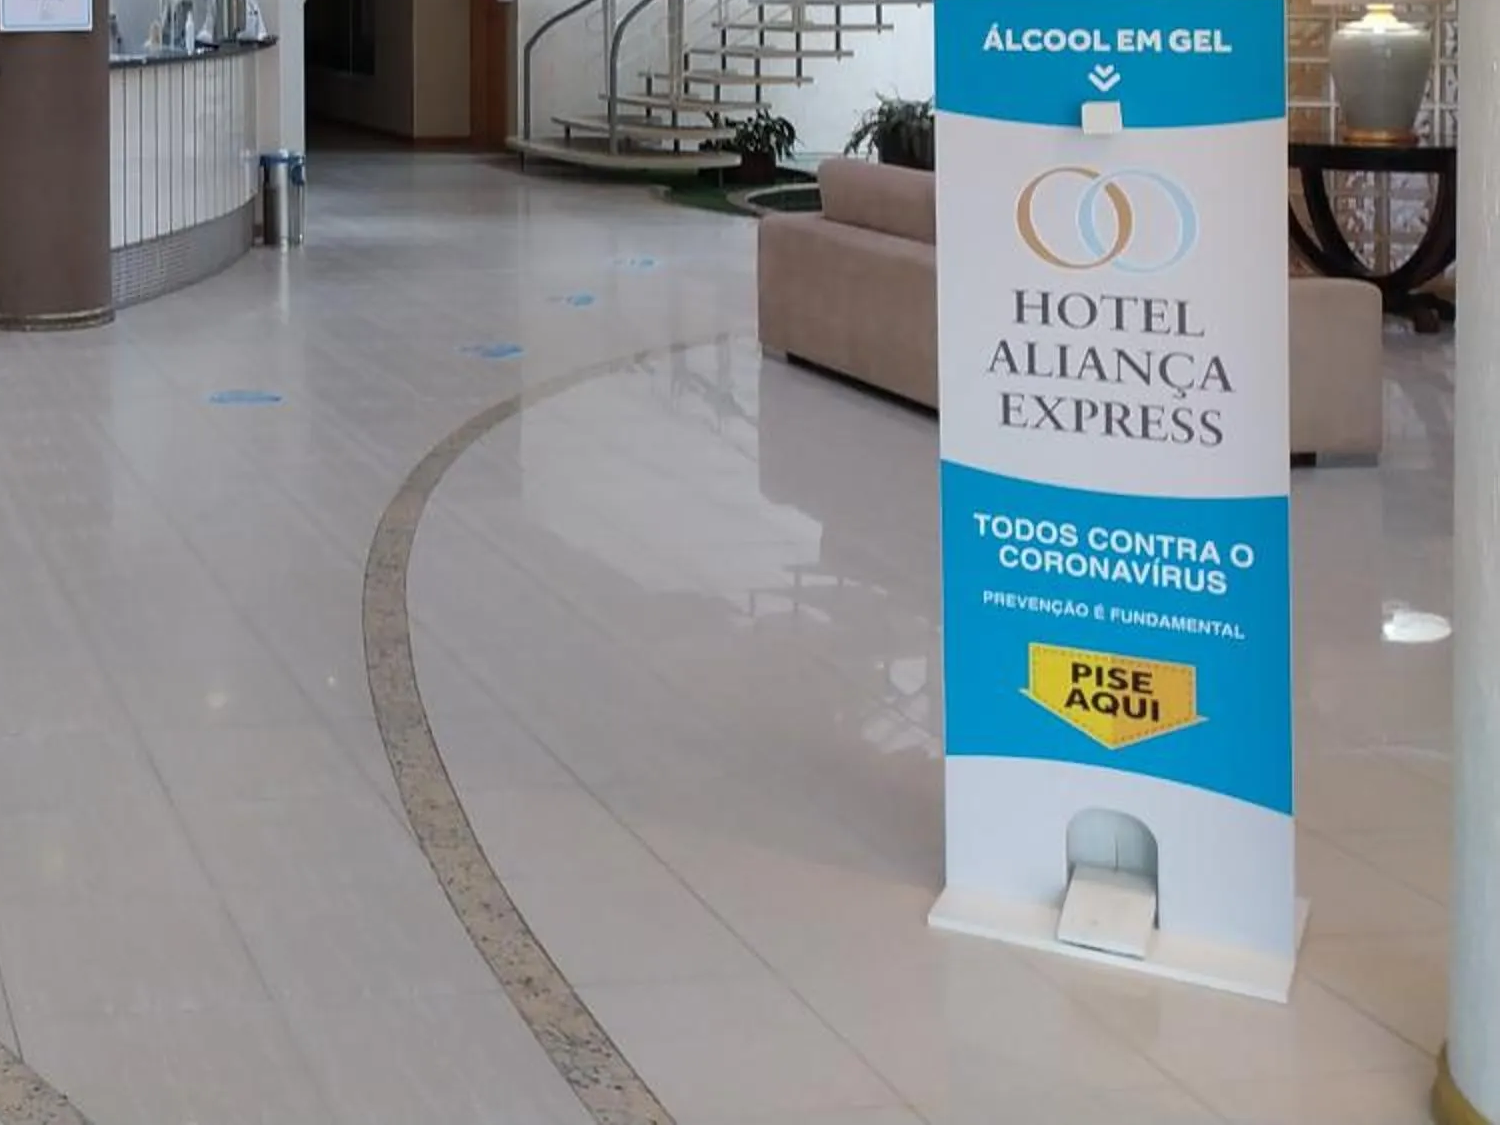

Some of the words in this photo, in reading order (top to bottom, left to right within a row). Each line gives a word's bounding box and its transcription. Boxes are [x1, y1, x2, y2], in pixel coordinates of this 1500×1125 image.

[983, 23, 1111, 52] ÁLCOOL
[1117, 29, 1162, 52] EM
[1169, 29, 1232, 53] GEL
[1011, 289, 1205, 337] HOTEL
[986, 339, 1236, 399] ALIANÇA
[999, 392, 1225, 448] EXPRESS
[974, 513, 1079, 547] TODOS
[1087, 527, 1221, 565] CONTRA
[1230, 544, 1255, 568] O
[999, 545, 1228, 595] CORONAVÍRUS
[983, 590, 1089, 617] PREVENÇÃO
[1094, 603, 1105, 620] É
[1110, 608, 1246, 639] FUNDAMENTAL
[1071, 662, 1154, 694] PISE
[1064, 688, 1160, 722] AQUI
